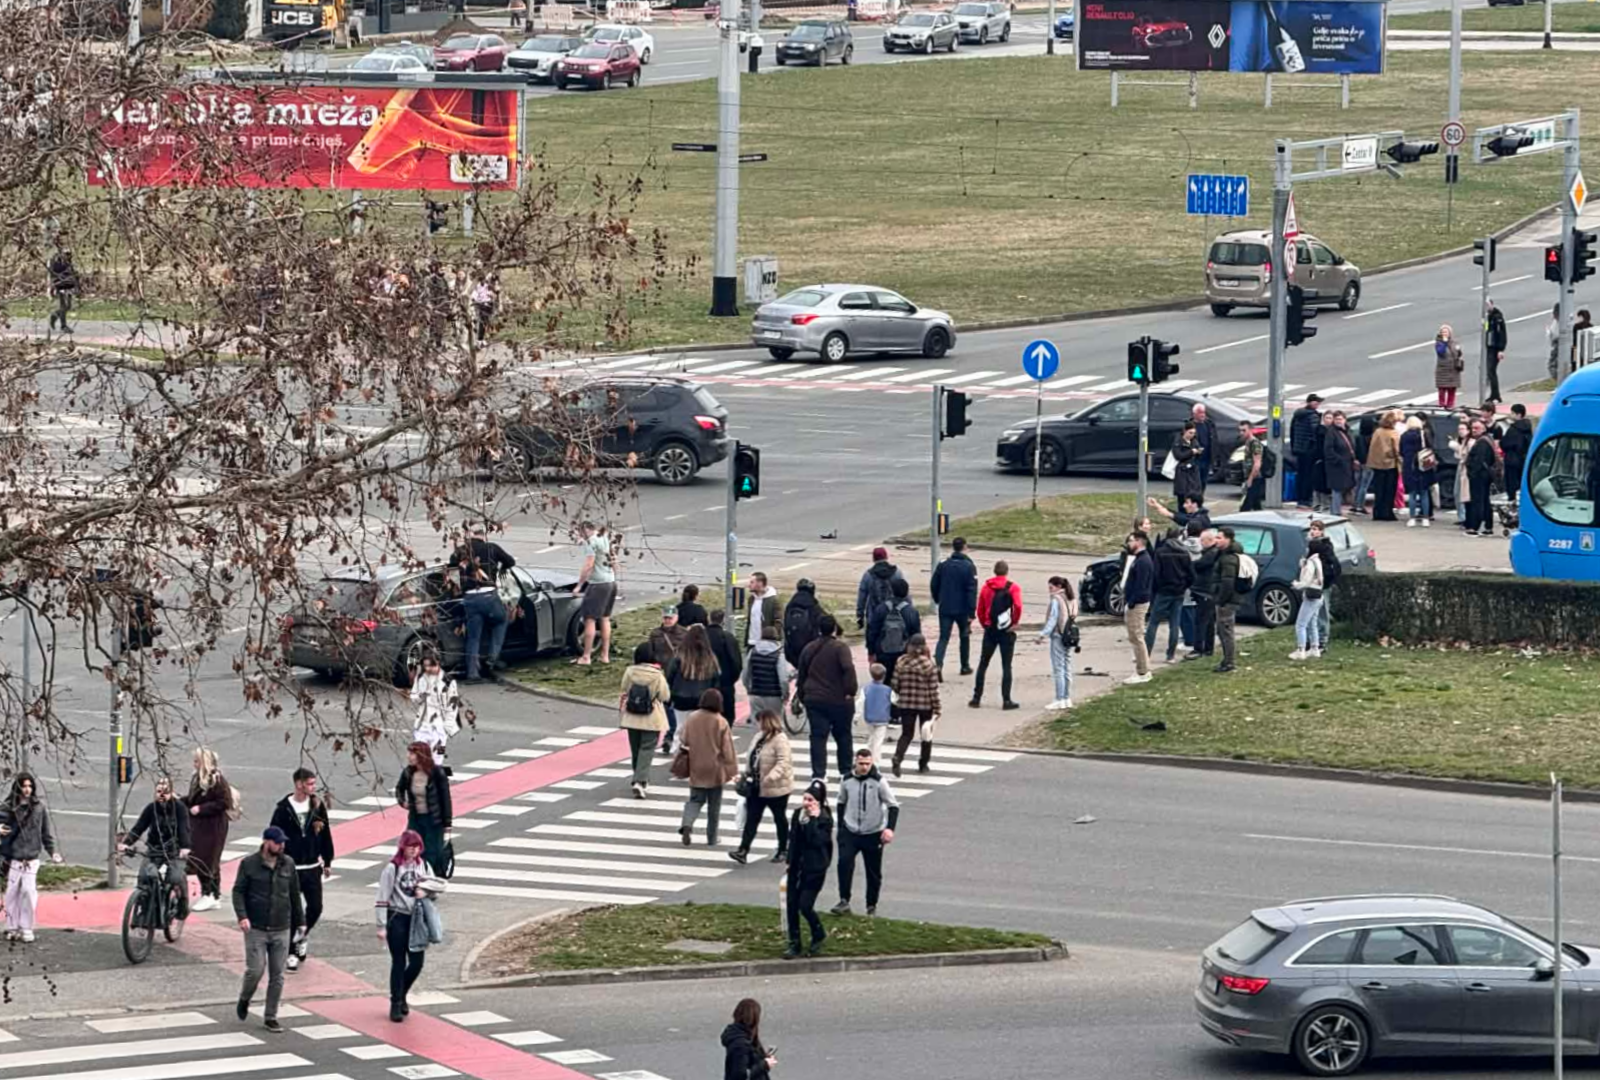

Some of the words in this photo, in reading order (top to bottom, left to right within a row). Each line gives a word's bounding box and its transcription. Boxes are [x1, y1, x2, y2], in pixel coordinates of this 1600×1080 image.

[271, 10, 315, 25] JCB
[265, 95, 380, 127] mreža
[1446, 128, 1461, 141] 60
[1548, 539, 1573, 550] 2287
